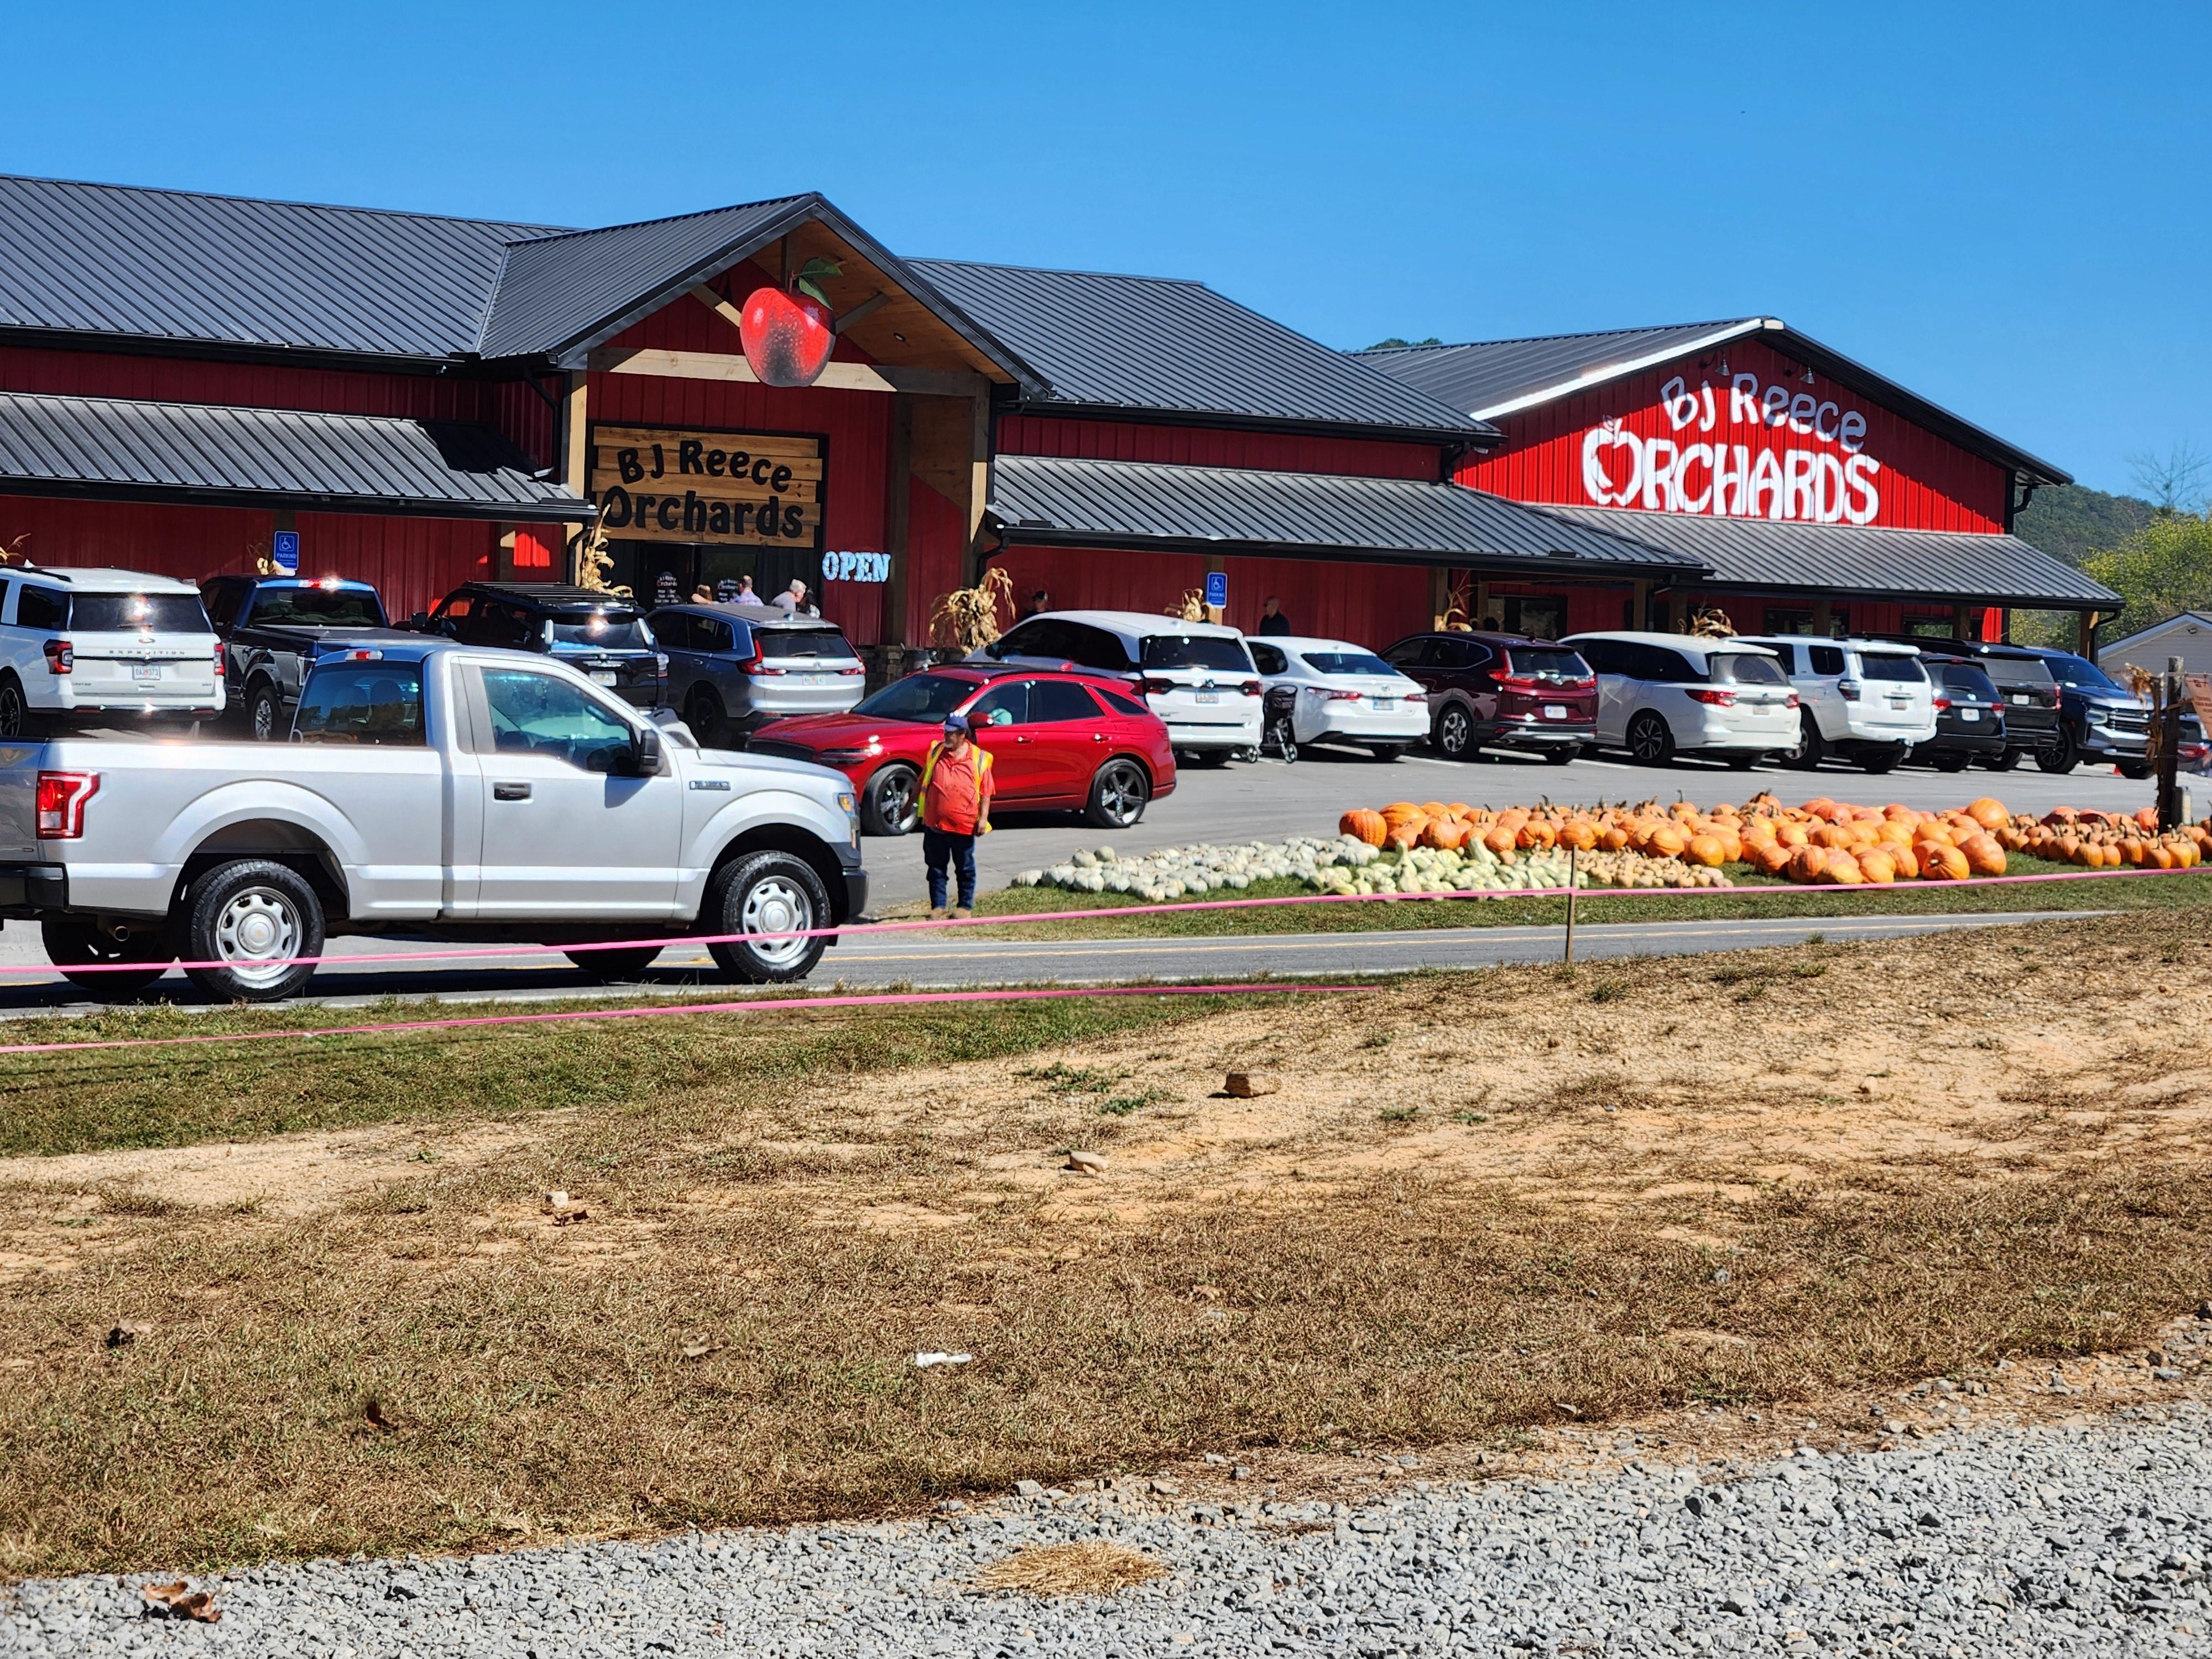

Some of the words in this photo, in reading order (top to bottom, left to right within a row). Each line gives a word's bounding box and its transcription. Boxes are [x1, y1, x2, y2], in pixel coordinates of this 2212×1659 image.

[1731, 373, 1867, 453] Reece
[618, 444, 664, 484] BJ
[680, 441, 792, 493] Reece
[1582, 426, 1880, 525] ORCHARDS
[602, 486, 804, 538] Orchards
[822, 551, 891, 582] OPEN
